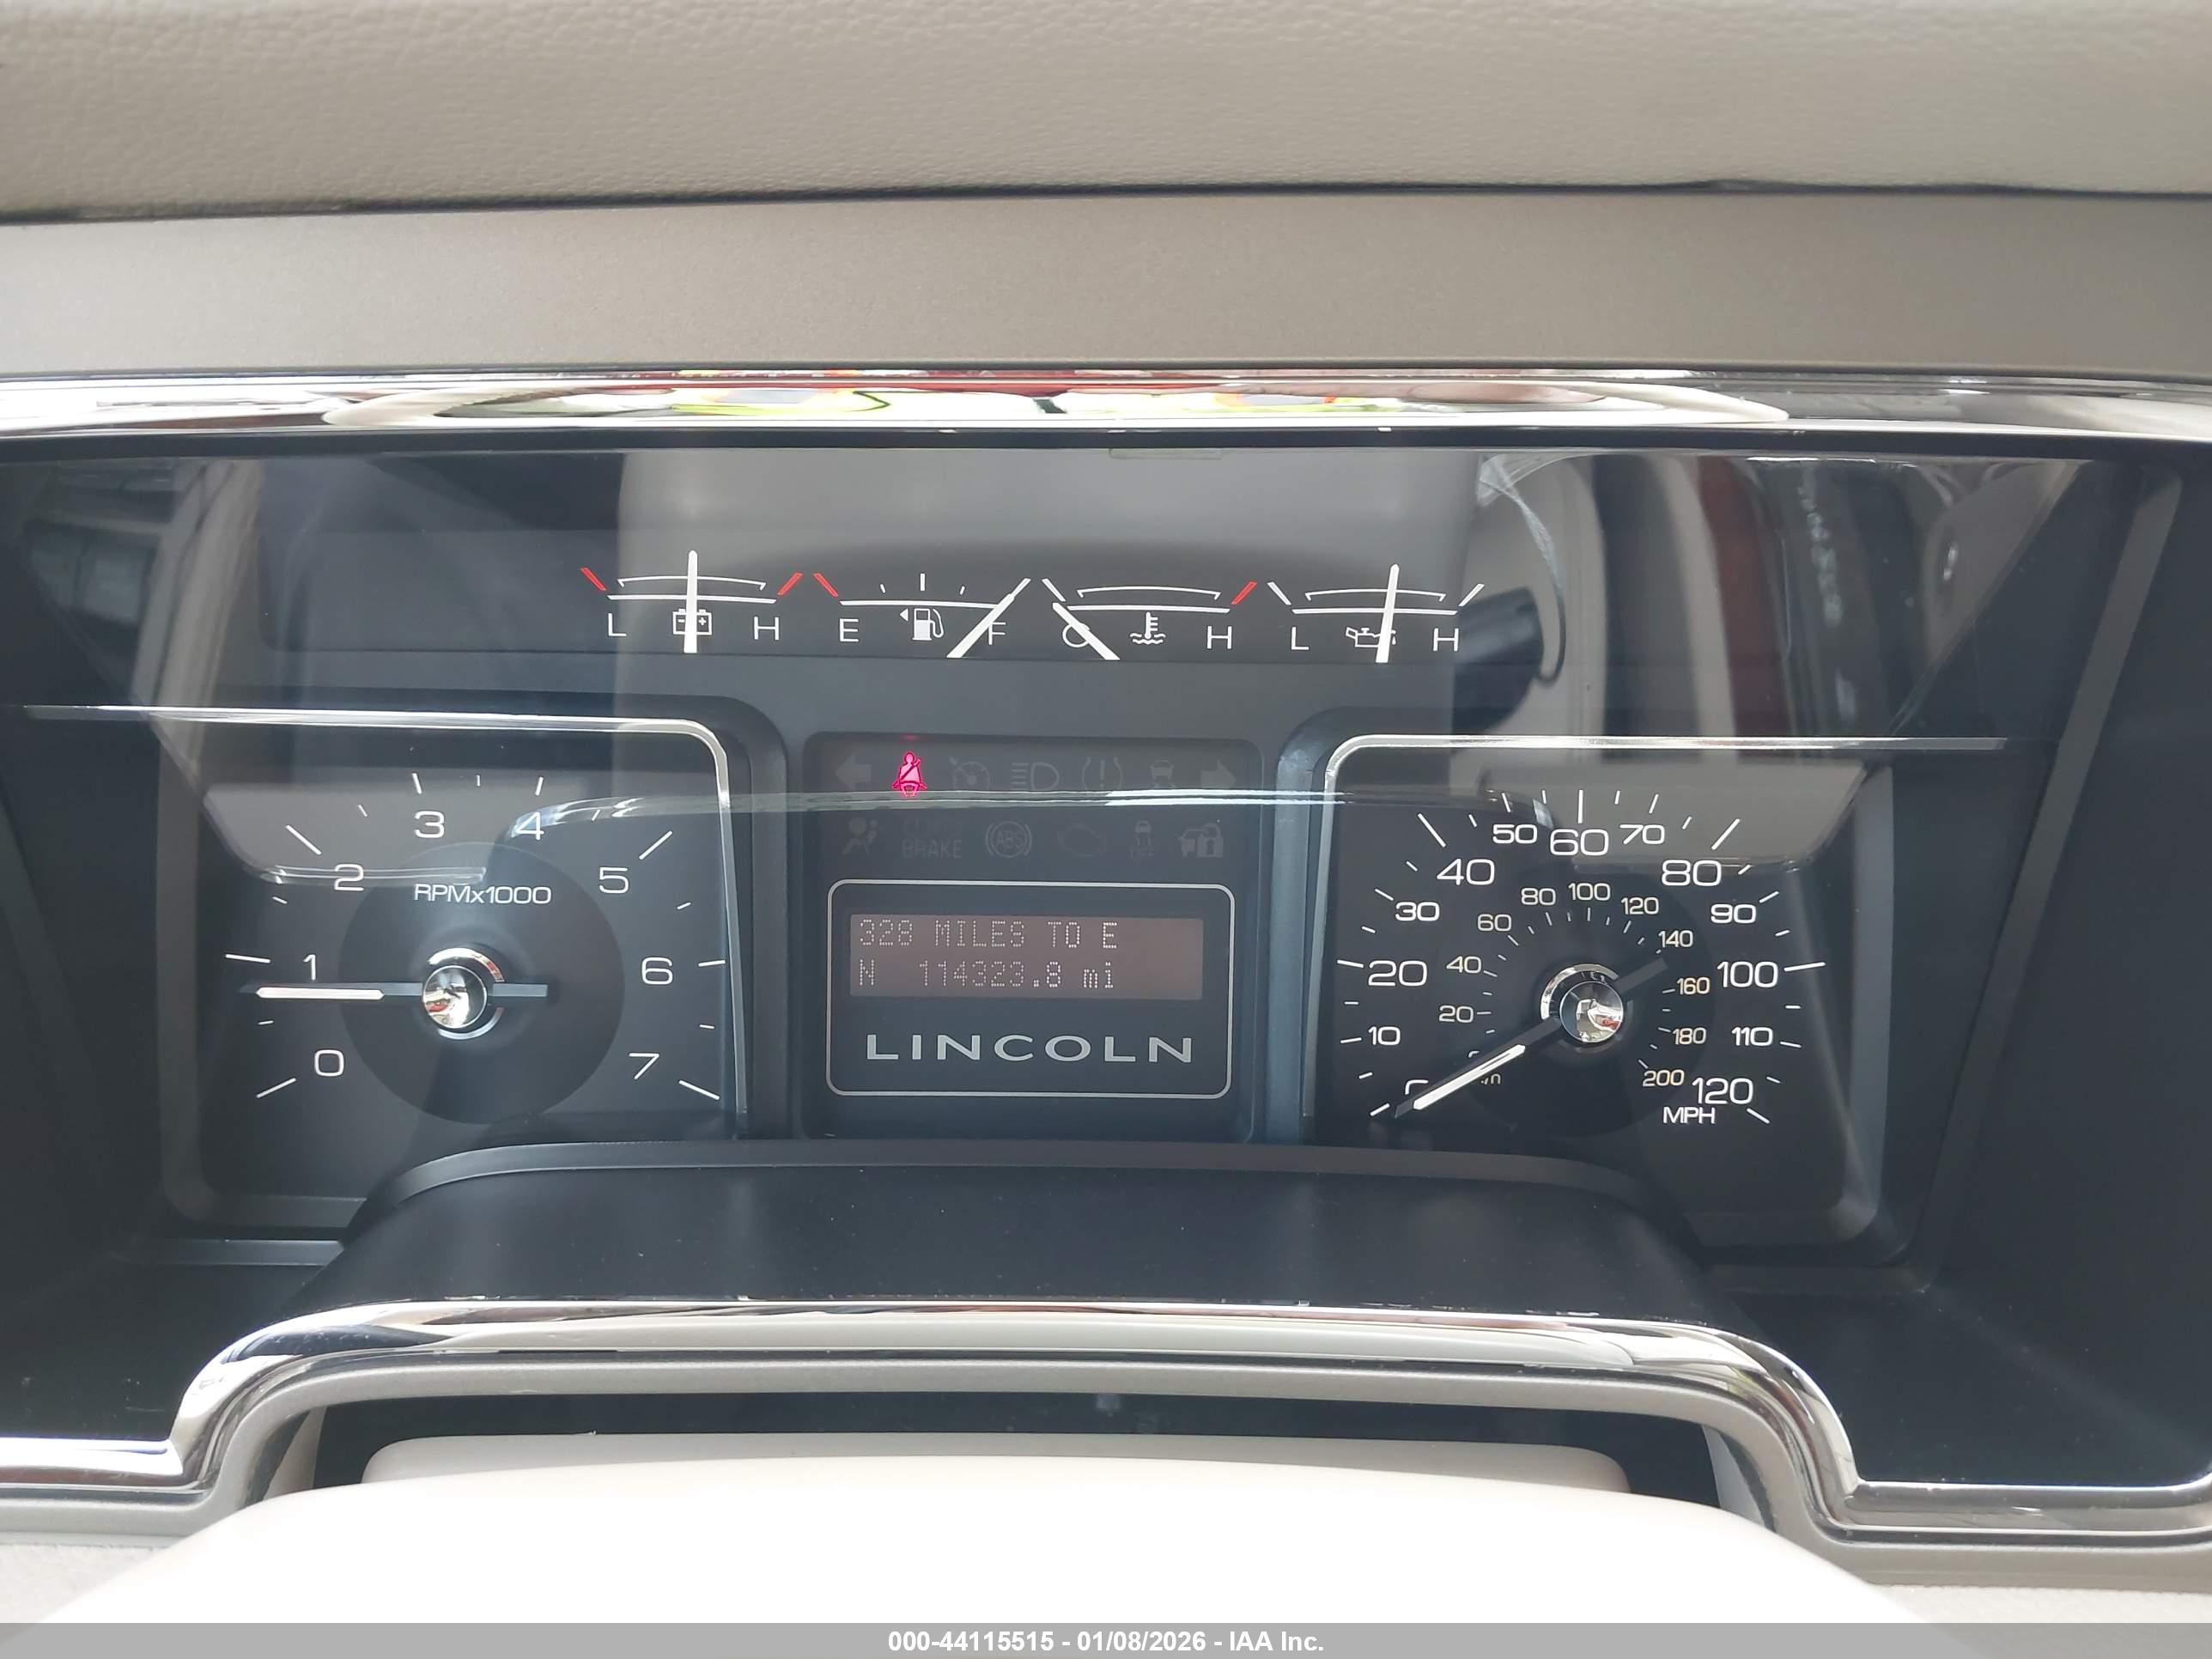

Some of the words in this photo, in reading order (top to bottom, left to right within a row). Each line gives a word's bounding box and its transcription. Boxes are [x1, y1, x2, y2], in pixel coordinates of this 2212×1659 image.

[608, 612, 627, 637] L
[753, 616, 780, 641] H
[839, 618, 859, 642] E
[1206, 625, 1232, 649] H
[1291, 626, 1310, 650] L
[1433, 628, 1459, 652] H
[414, 811, 445, 838] 3
[515, 811, 545, 842] 4
[1492, 823, 1538, 844] 50
[1620, 823, 1665, 845] 70
[902, 839, 962, 859] BRAKE
[994, 830, 1025, 850] ABS
[1550, 829, 1609, 856] 60
[332, 862, 366, 893] 2
[599, 866, 629, 894] 5
[1437, 858, 1495, 886] 40
[1659, 859, 1724, 888] 80
[415, 882, 551, 904] RPMx1000
[1521, 887, 1556, 906] 80
[1568, 883, 1611, 901] 100
[1395, 902, 1440, 921] 30
[1620, 896, 1659, 915] 120
[1711, 903, 1757, 924] 90
[860, 919, 913, 946] 328
[935, 920, 1024, 947] MILES
[1048, 921, 1080, 948] TO
[1103, 922, 1117, 949] E
[1477, 914, 1512, 932] 60
[1658, 930, 1693, 948] 140
[303, 954, 316, 981] 1
[641, 957, 673, 985] 6
[860, 959, 874, 986] N
[919, 960, 1061, 988] 114323.8
[1083, 962, 1114, 988] mi
[1368, 960, 1428, 987] 20
[1446, 956, 1482, 974] 40
[1717, 961, 1778, 988] 100
[1677, 976, 1711, 995] 160
[1438, 1005, 1474, 1024] 20
[1368, 1026, 1401, 1046] 10
[1673, 1027, 1706, 1045] 180
[1731, 1026, 1773, 1047] 110
[866, 1034, 1192, 1063] LINCOLN
[314, 1049, 344, 1077] 0
[629, 1053, 659, 1079] 7
[1642, 1069, 1685, 1087] 200
[1692, 1077, 1753, 1104] 120
[1662, 1106, 1716, 1124] MPH
